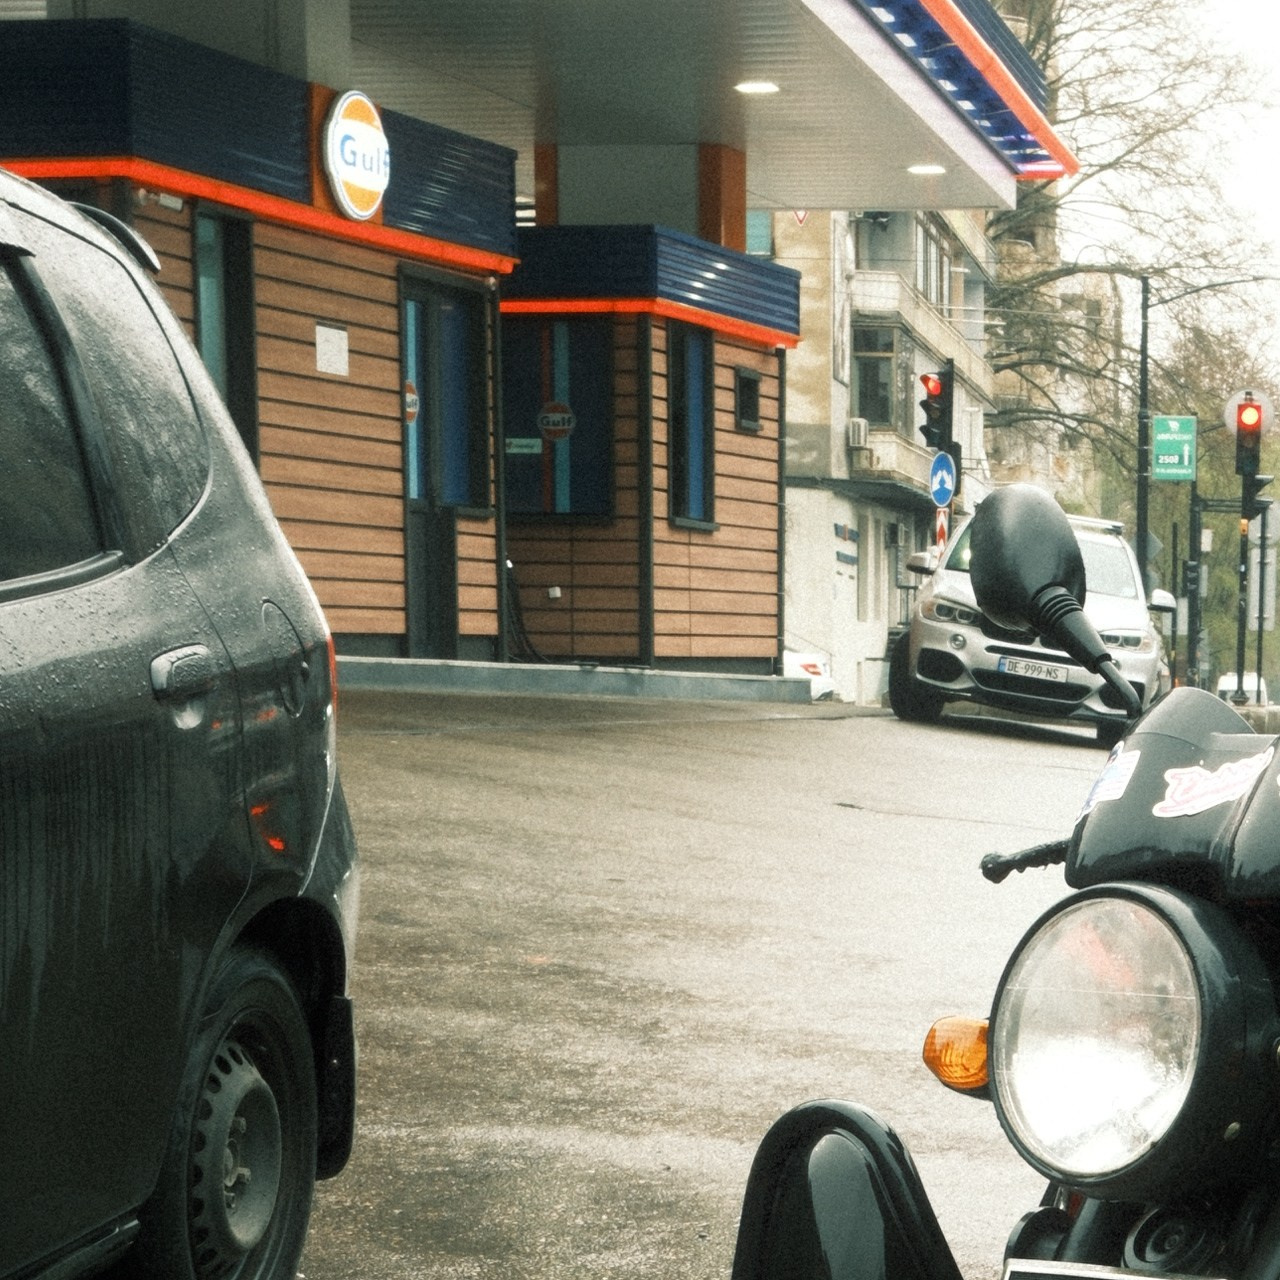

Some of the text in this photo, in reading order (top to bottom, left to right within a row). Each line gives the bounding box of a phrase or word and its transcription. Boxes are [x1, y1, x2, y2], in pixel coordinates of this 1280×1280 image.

[340, 133, 391, 178] Gulf
[540, 415, 573, 427] Gulf
[1007, 660, 1059, 680] DE-999-NS
